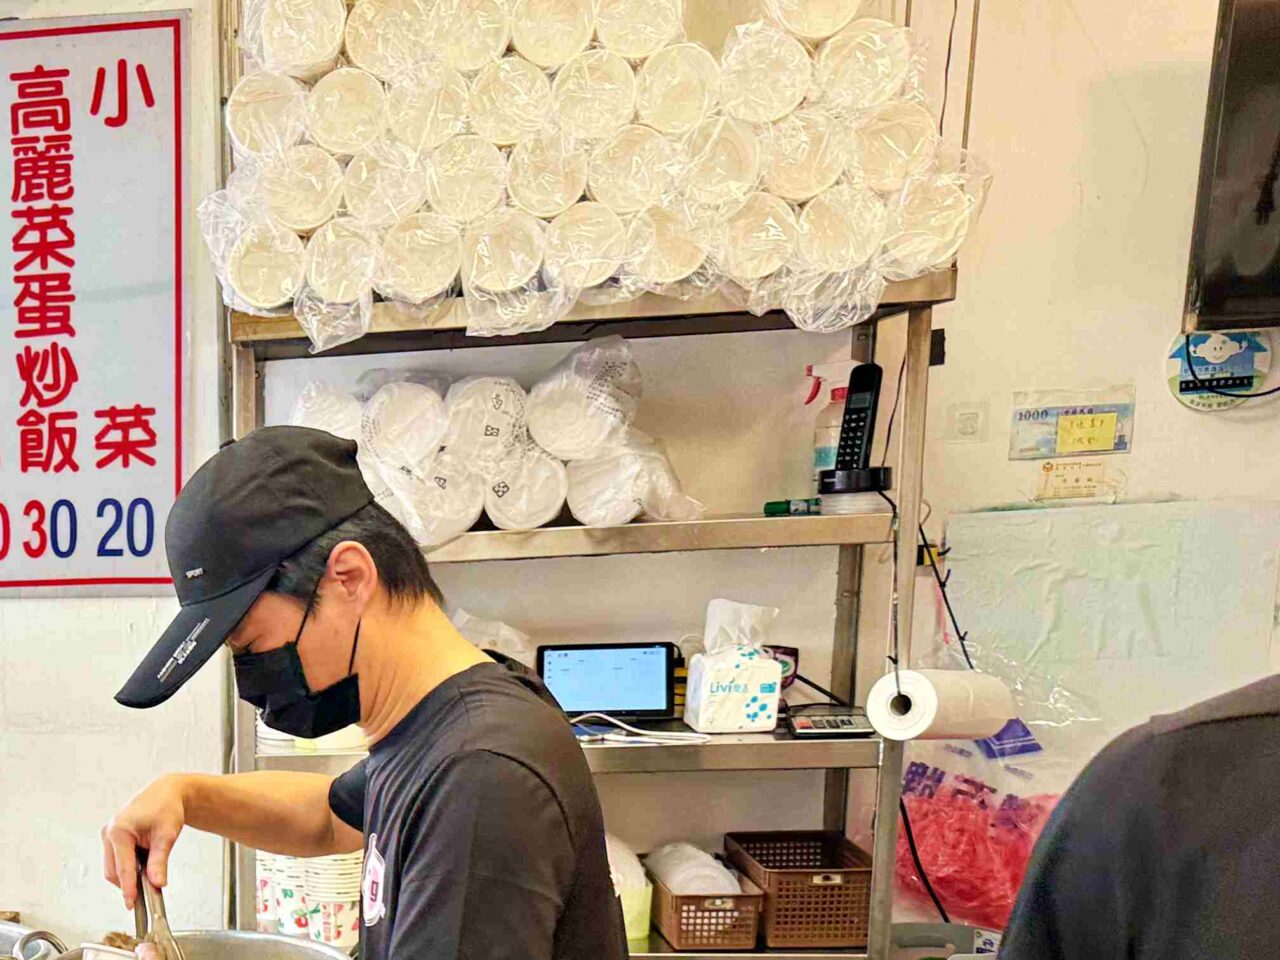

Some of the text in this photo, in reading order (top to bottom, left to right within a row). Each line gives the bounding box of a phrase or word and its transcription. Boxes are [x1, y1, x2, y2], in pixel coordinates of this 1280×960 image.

[9, 64, 80, 475] 高麗菜蛋炒飯
[22, 499, 78, 559] 30
[96, 497, 155, 558] 20
